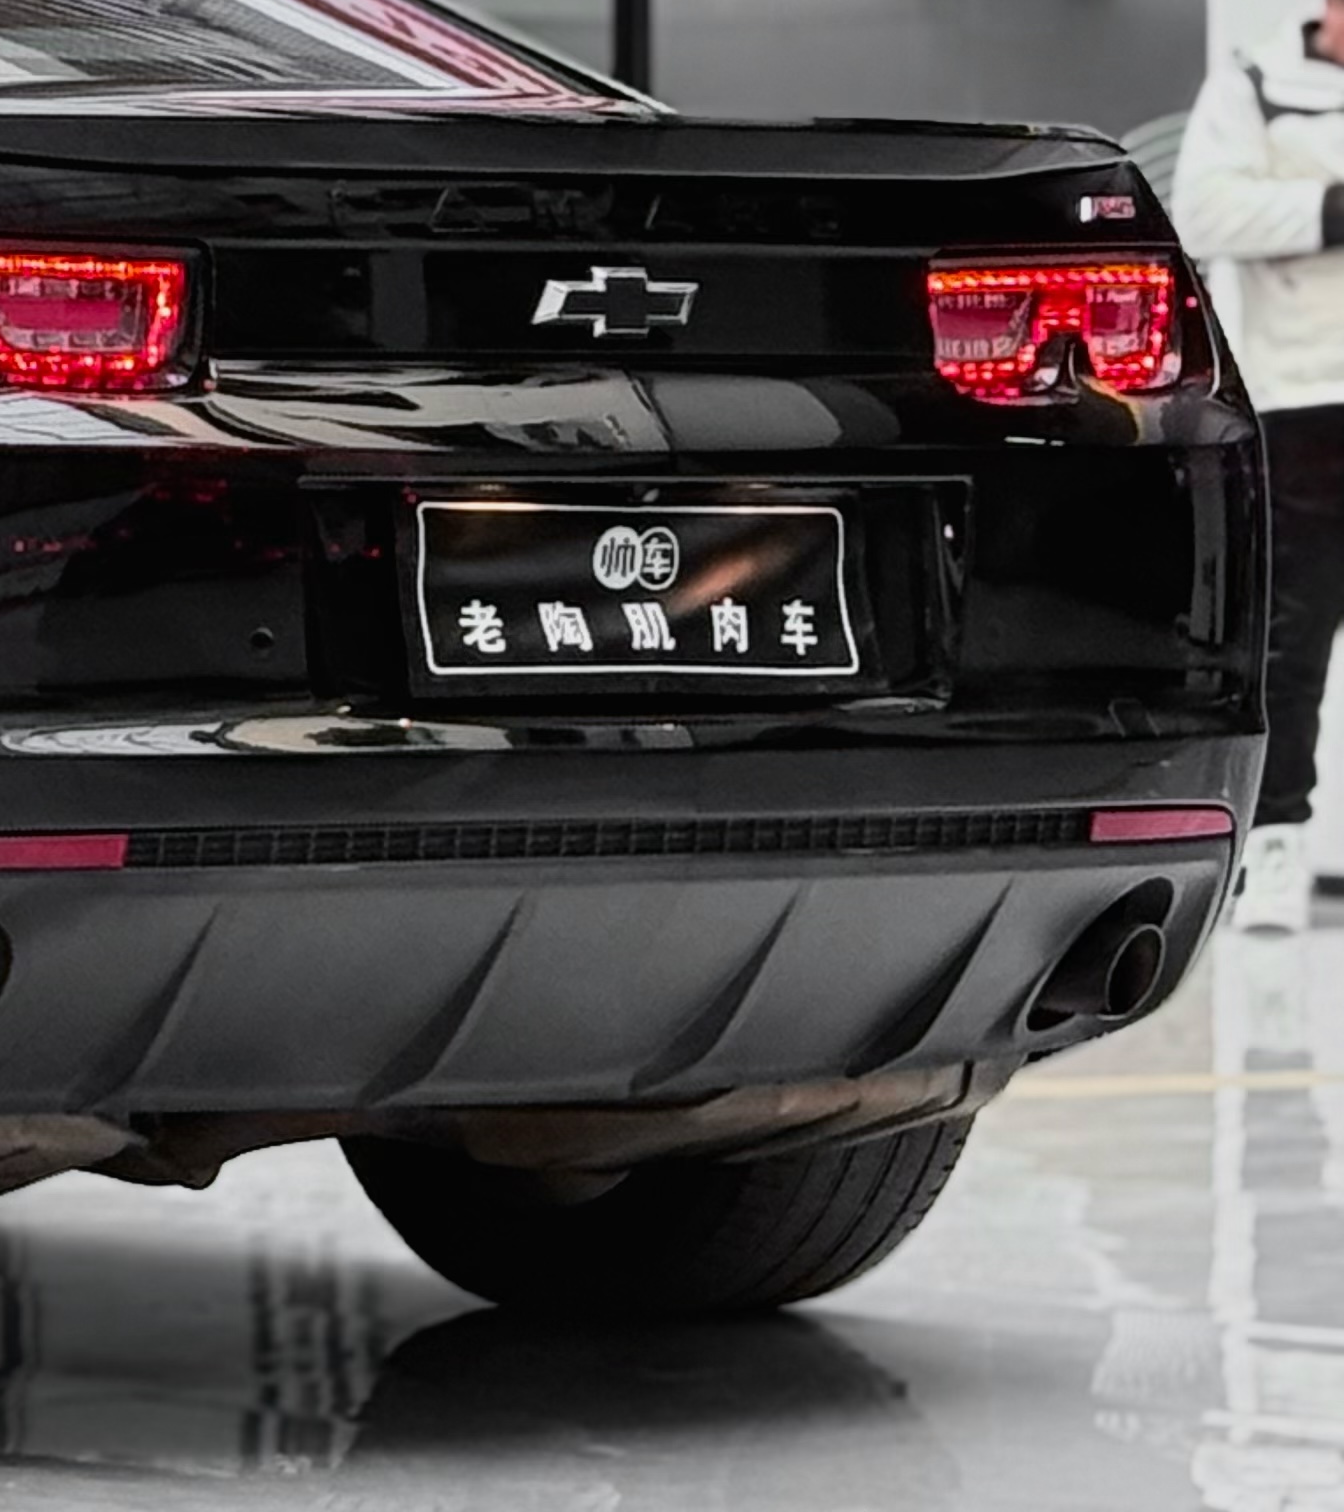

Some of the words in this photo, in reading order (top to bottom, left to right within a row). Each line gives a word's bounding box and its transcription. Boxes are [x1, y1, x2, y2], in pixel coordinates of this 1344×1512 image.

[458, 597, 819, 656] 老陶肌肉车
